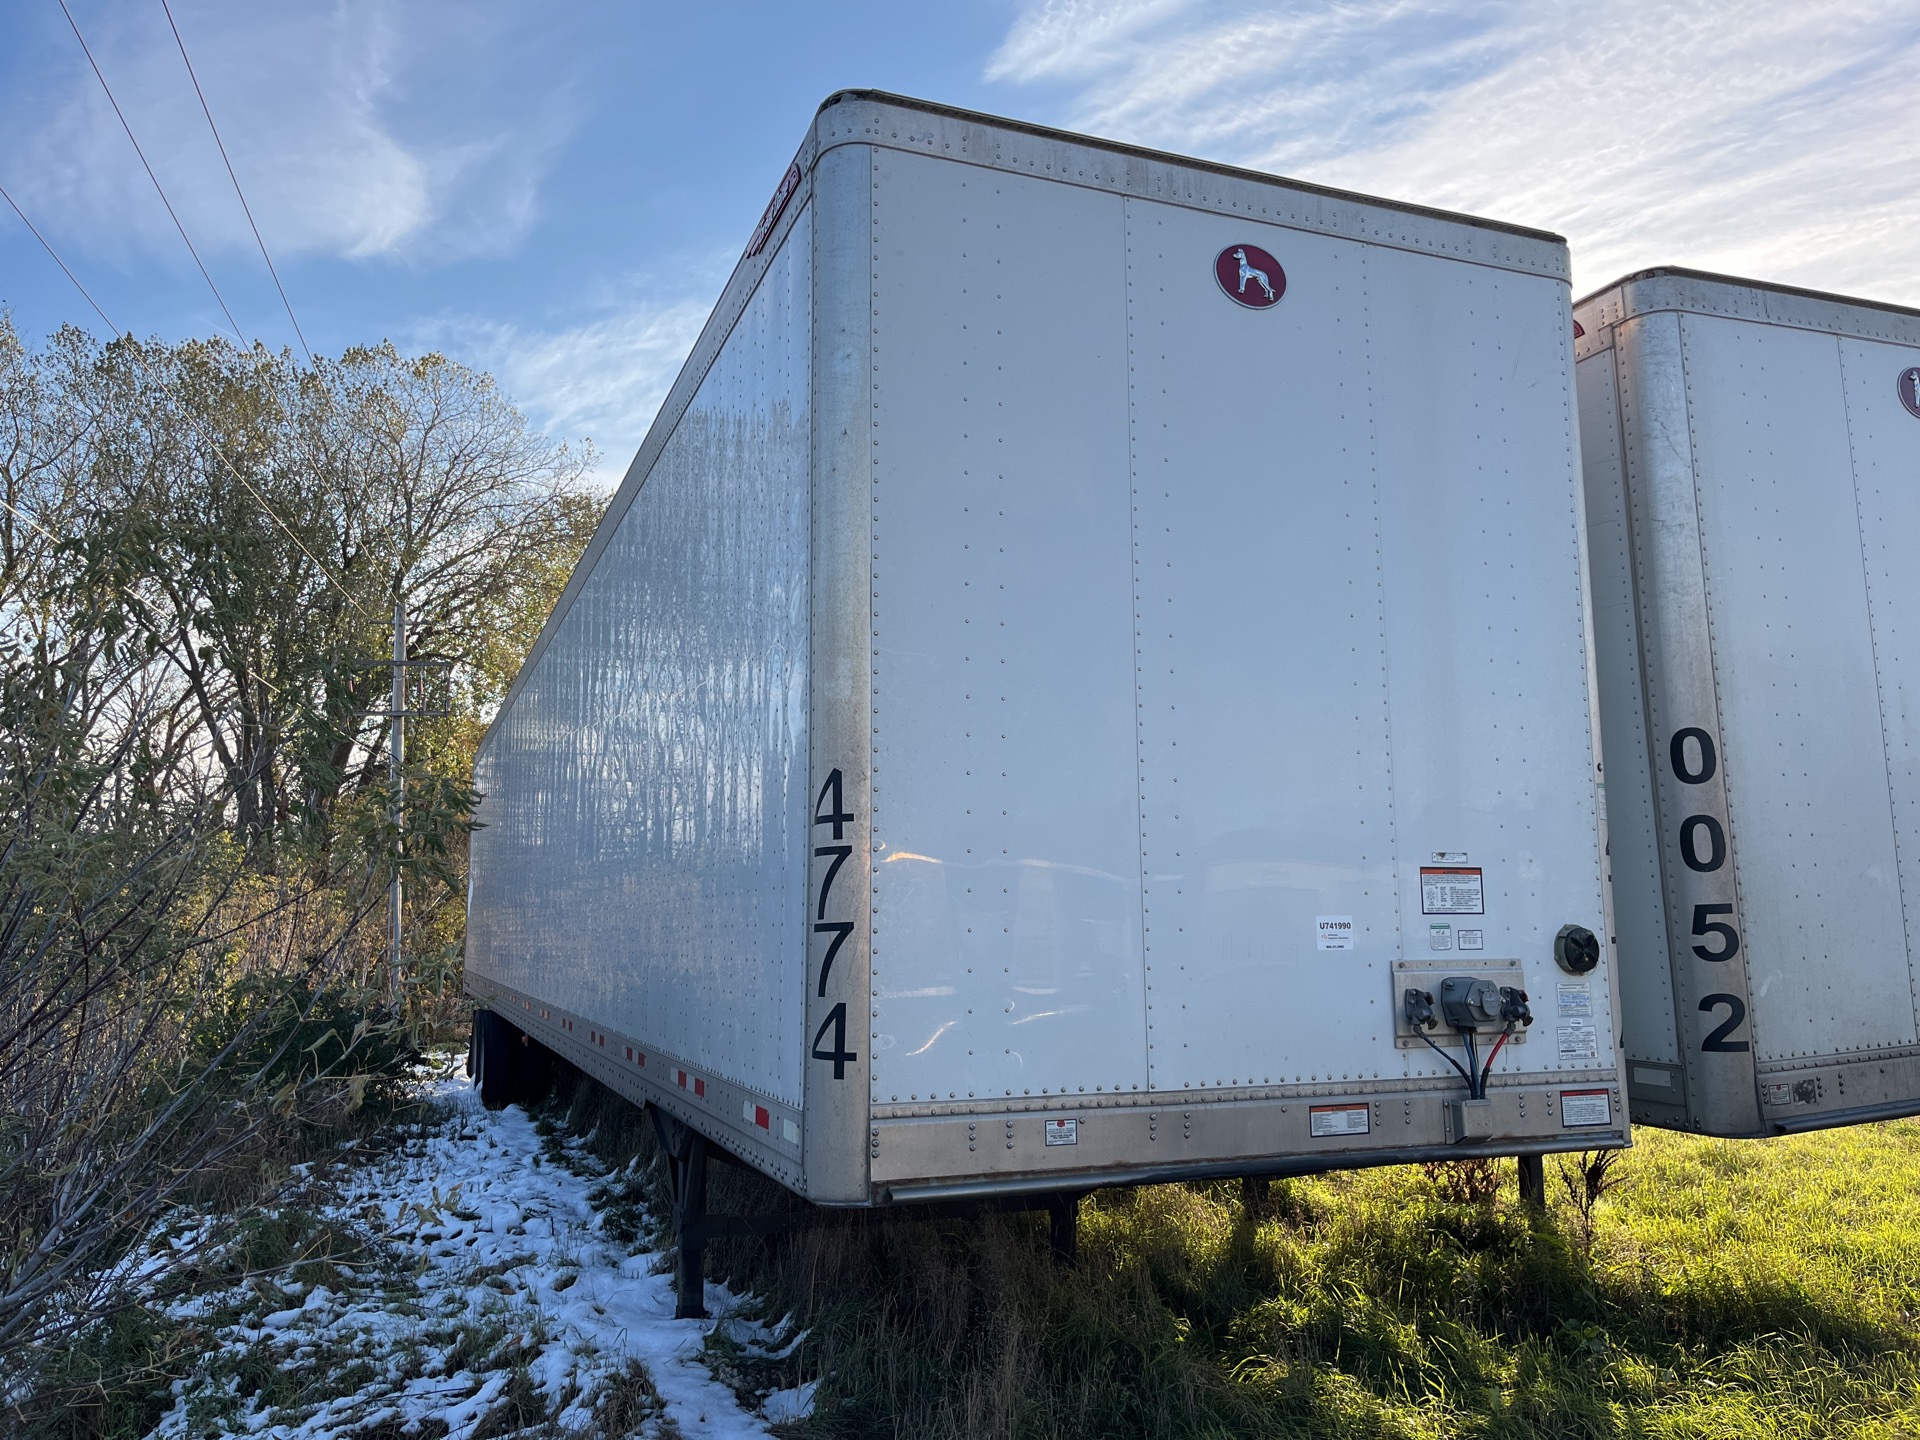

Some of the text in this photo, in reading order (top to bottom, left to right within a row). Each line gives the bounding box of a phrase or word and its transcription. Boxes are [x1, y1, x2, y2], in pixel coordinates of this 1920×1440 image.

[812, 768, 857, 1080] 4774
[1319, 922, 1351, 930] U741990
[1669, 727, 1750, 1053] 0052
